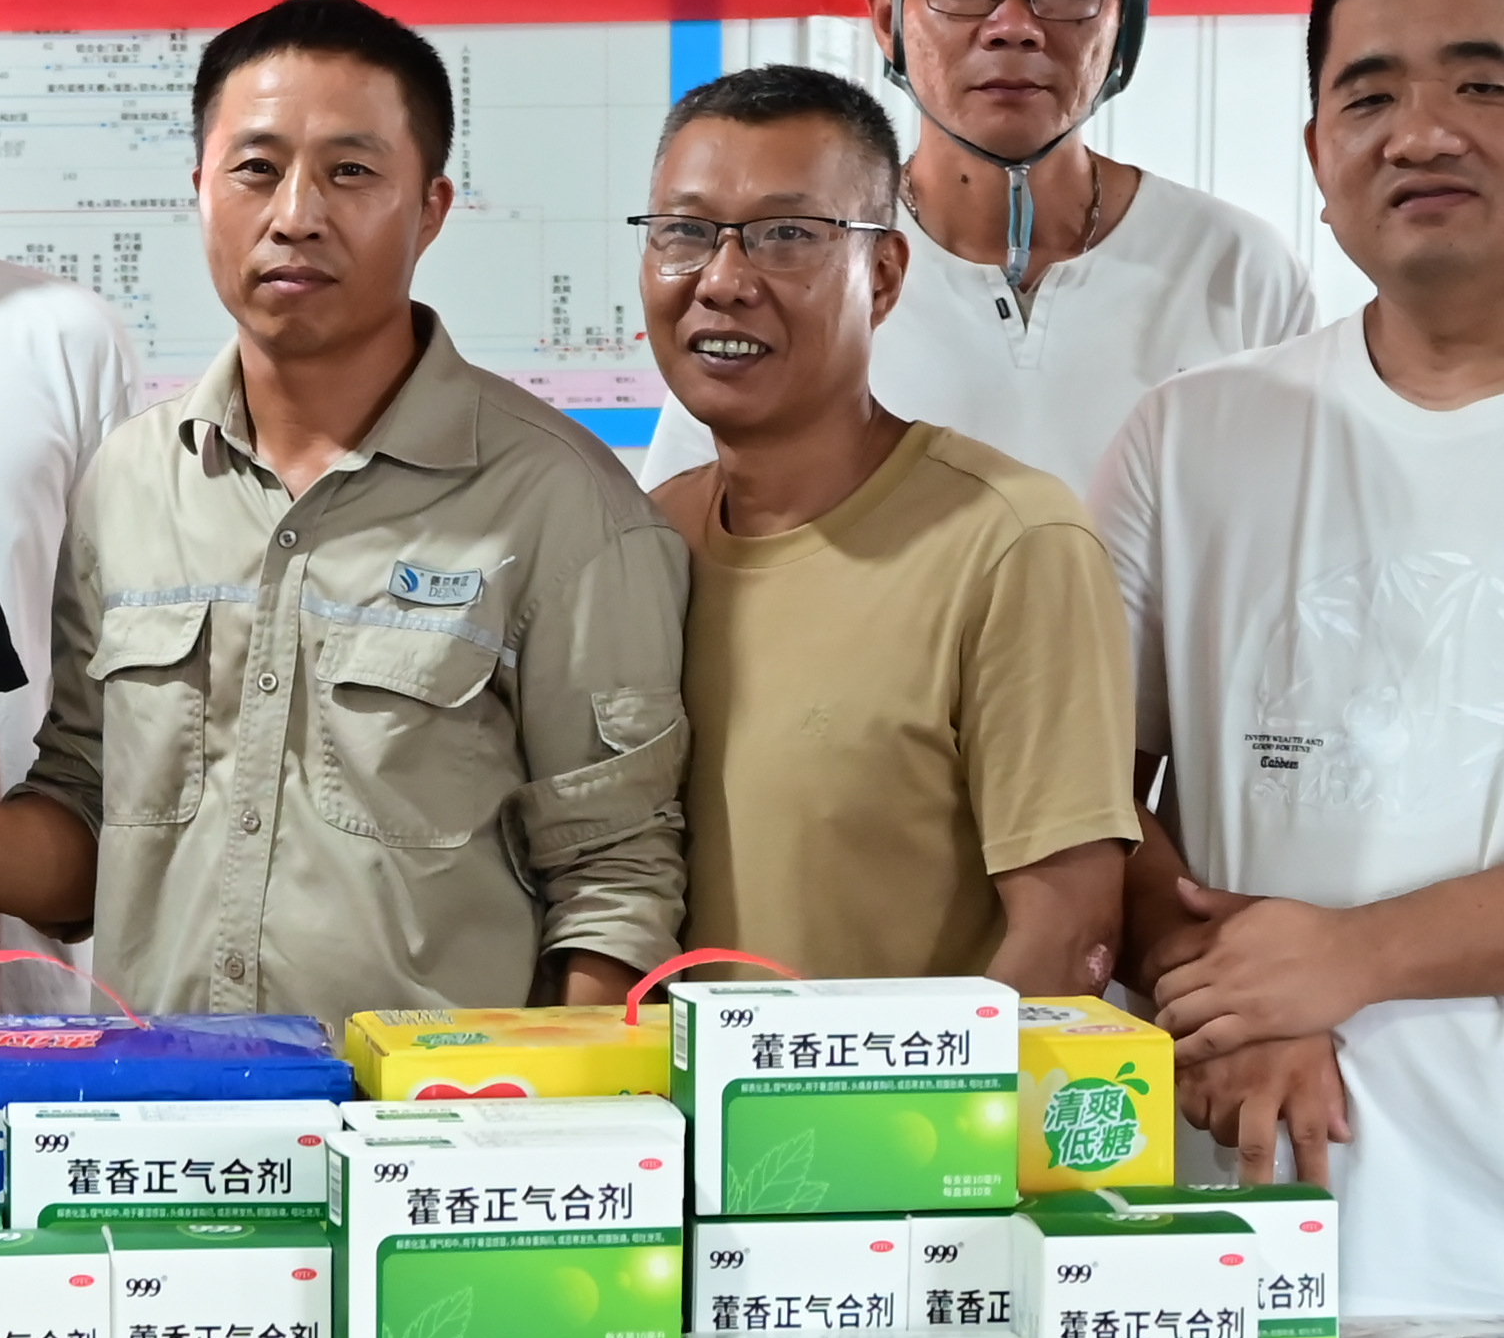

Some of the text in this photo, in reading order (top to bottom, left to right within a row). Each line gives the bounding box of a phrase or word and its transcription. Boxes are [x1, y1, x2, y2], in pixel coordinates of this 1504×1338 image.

[720, 1010, 753, 1027] 999
[752, 1030, 969, 1069] 藿香正气合剂
[1048, 1084, 1123, 1125] 清爽
[35, 1135, 69, 1152] 999
[1059, 1121, 1135, 1166] 低糖
[68, 1158, 291, 1194] 藿香正气合剂
[374, 1164, 408, 1182] 999
[408, 1183, 632, 1225] 藿香正气合剂
[710, 1251, 743, 1269] 999
[925, 1245, 958, 1263] 999
[1058, 1265, 1091, 1283] 999
[126, 1279, 161, 1296] 999
[713, 1293, 893, 1330] 藿香正气合剂
